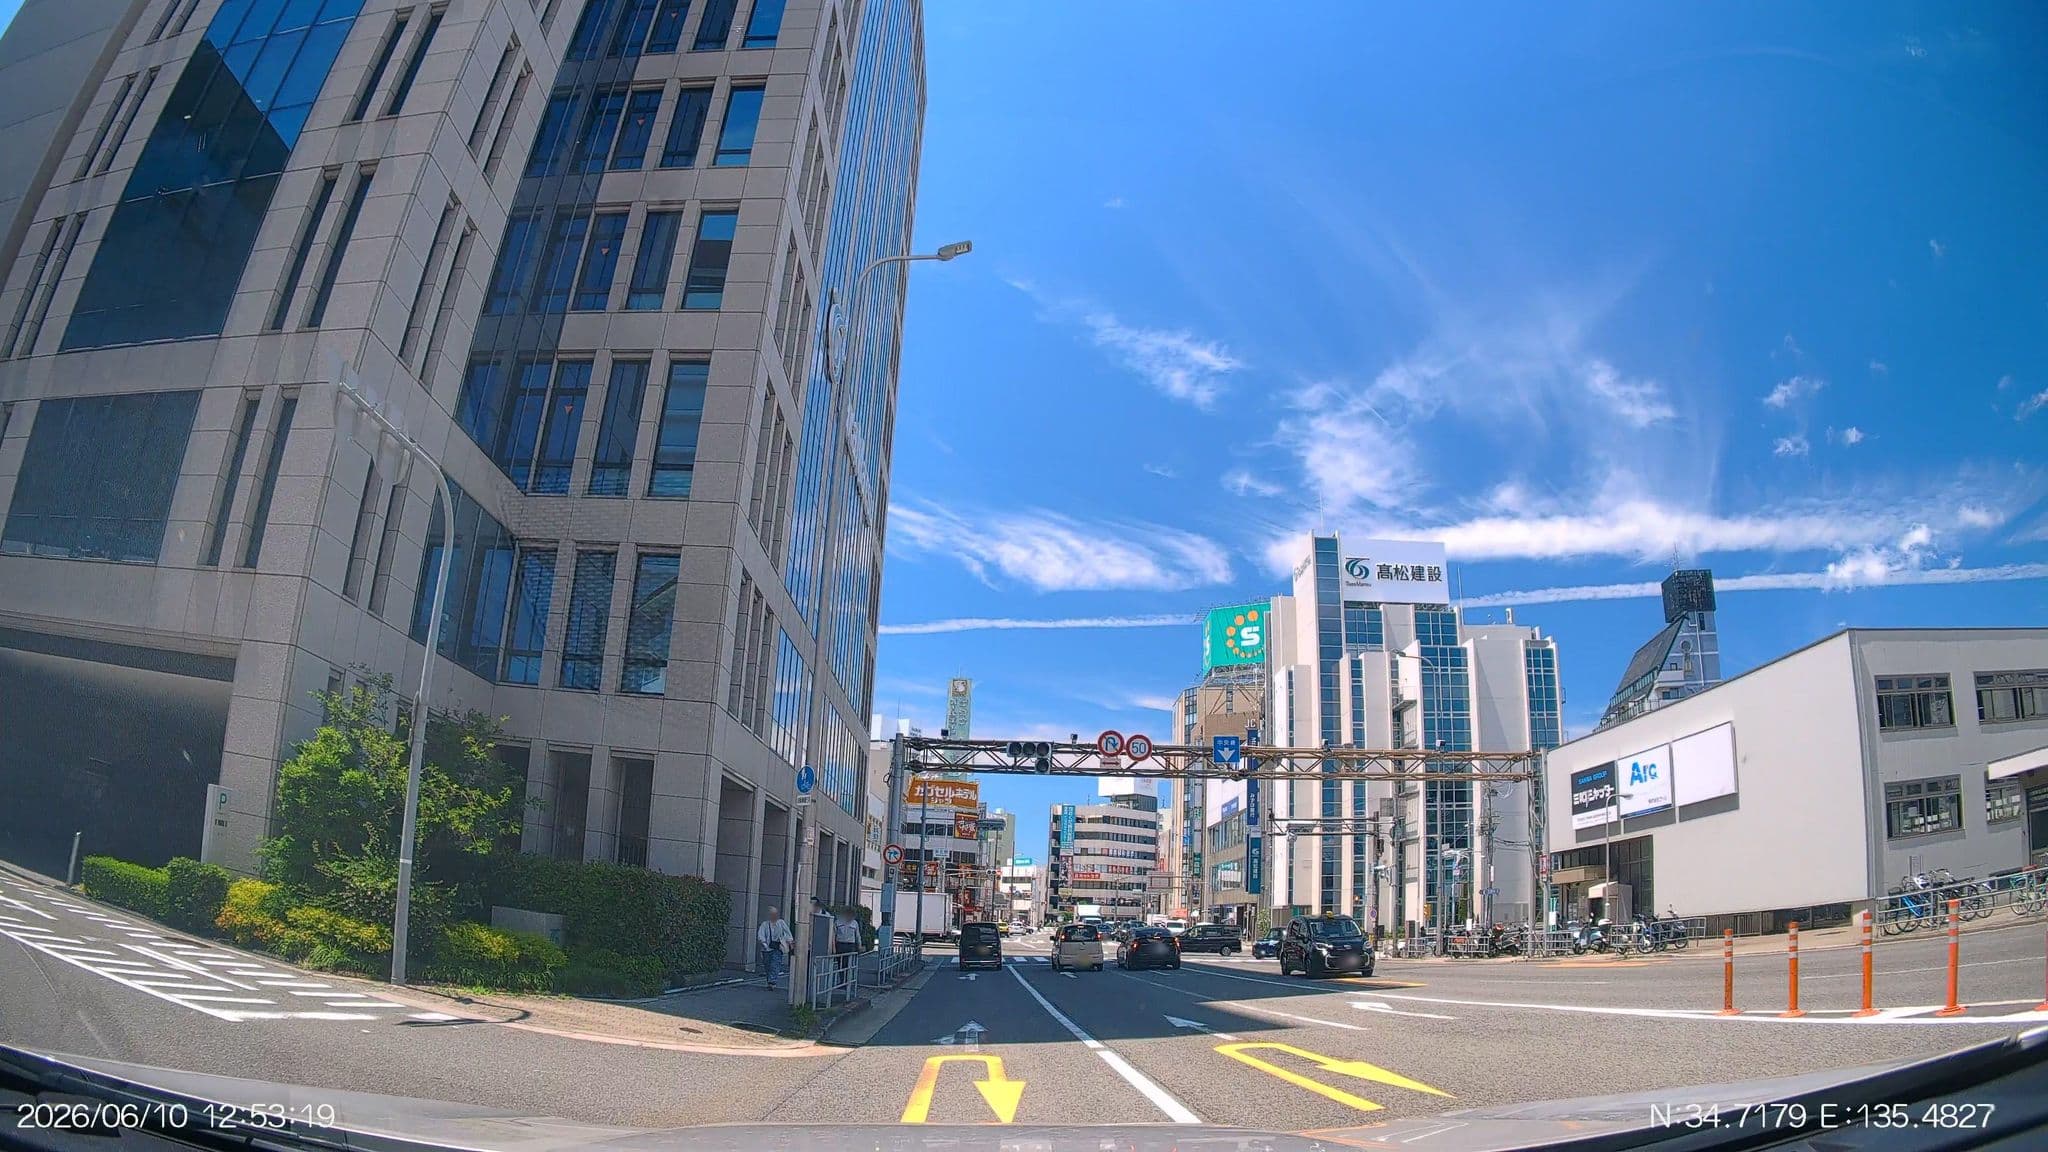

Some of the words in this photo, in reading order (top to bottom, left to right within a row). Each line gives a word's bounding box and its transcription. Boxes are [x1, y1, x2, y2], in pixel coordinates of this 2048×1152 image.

[1240, 626, 1260, 646] S
[1131, 742, 1147, 754] 50
[1630, 762, 1658, 786] Arc
[219, 793, 227, 810] P
[1573, 783, 1615, 808] 三和シャッター
